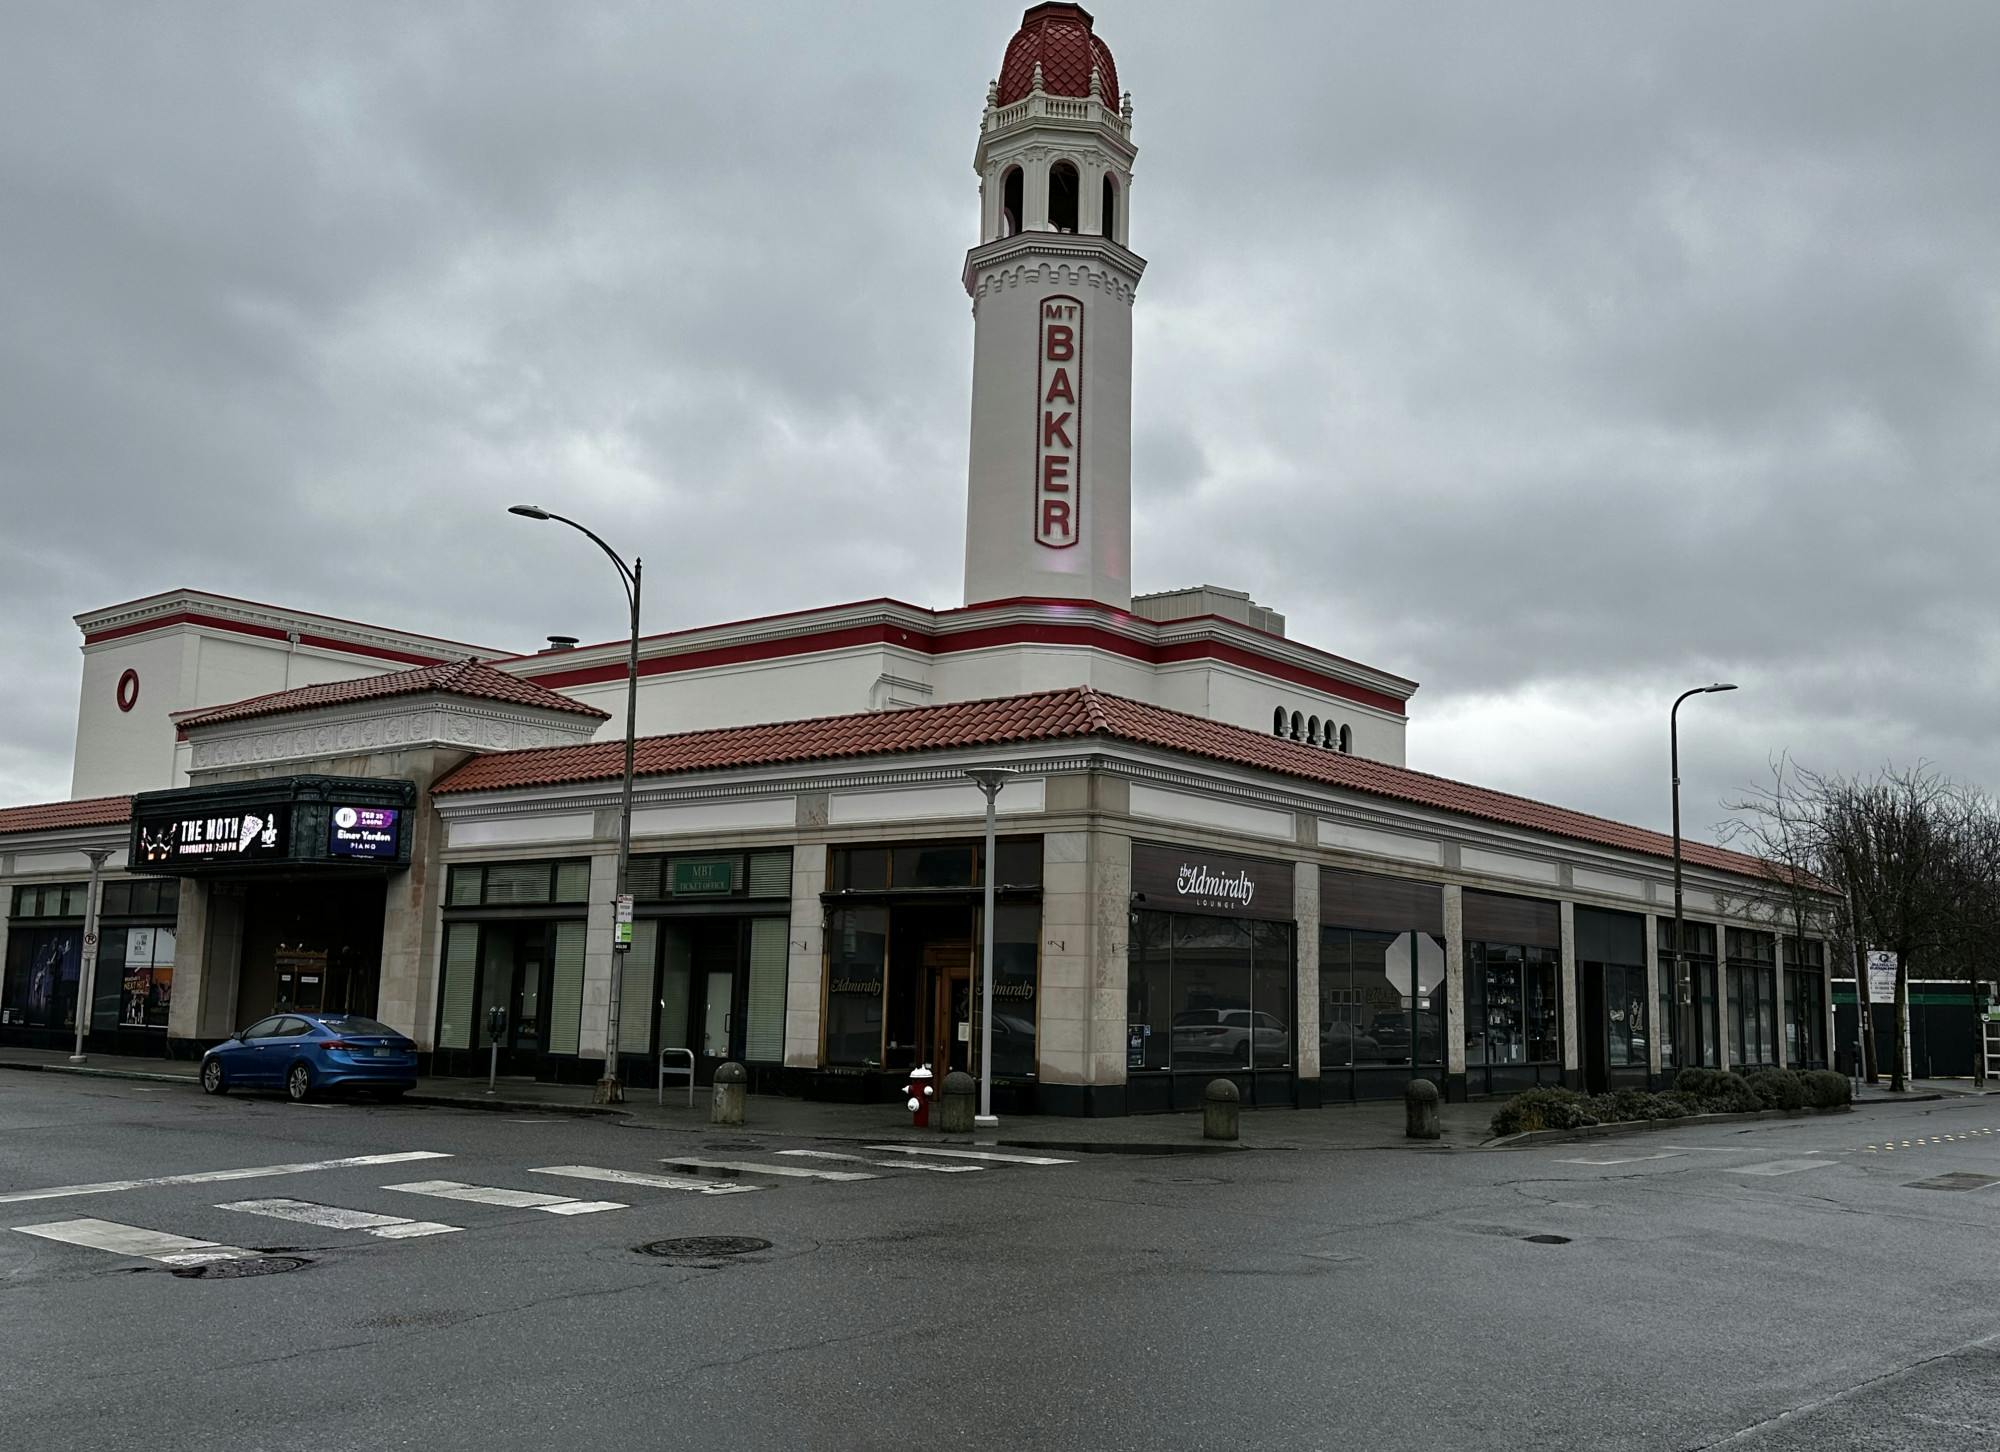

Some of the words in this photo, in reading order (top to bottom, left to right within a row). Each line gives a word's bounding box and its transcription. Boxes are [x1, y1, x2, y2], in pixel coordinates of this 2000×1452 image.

[1046, 304, 1077, 321] MT
[1043, 324, 1075, 537] BAKER
[181, 820, 203, 842] THE
[206, 817, 239, 840] MOTH
[179, 843, 205, 854] FEBRUARY
[228, 842, 237, 851] PM
[350, 842, 376, 850] PIANO
[1179, 863, 1192, 878] the
[1177, 865, 1255, 906] Admiralty
[1196, 899, 1236, 909] LOUNGE
